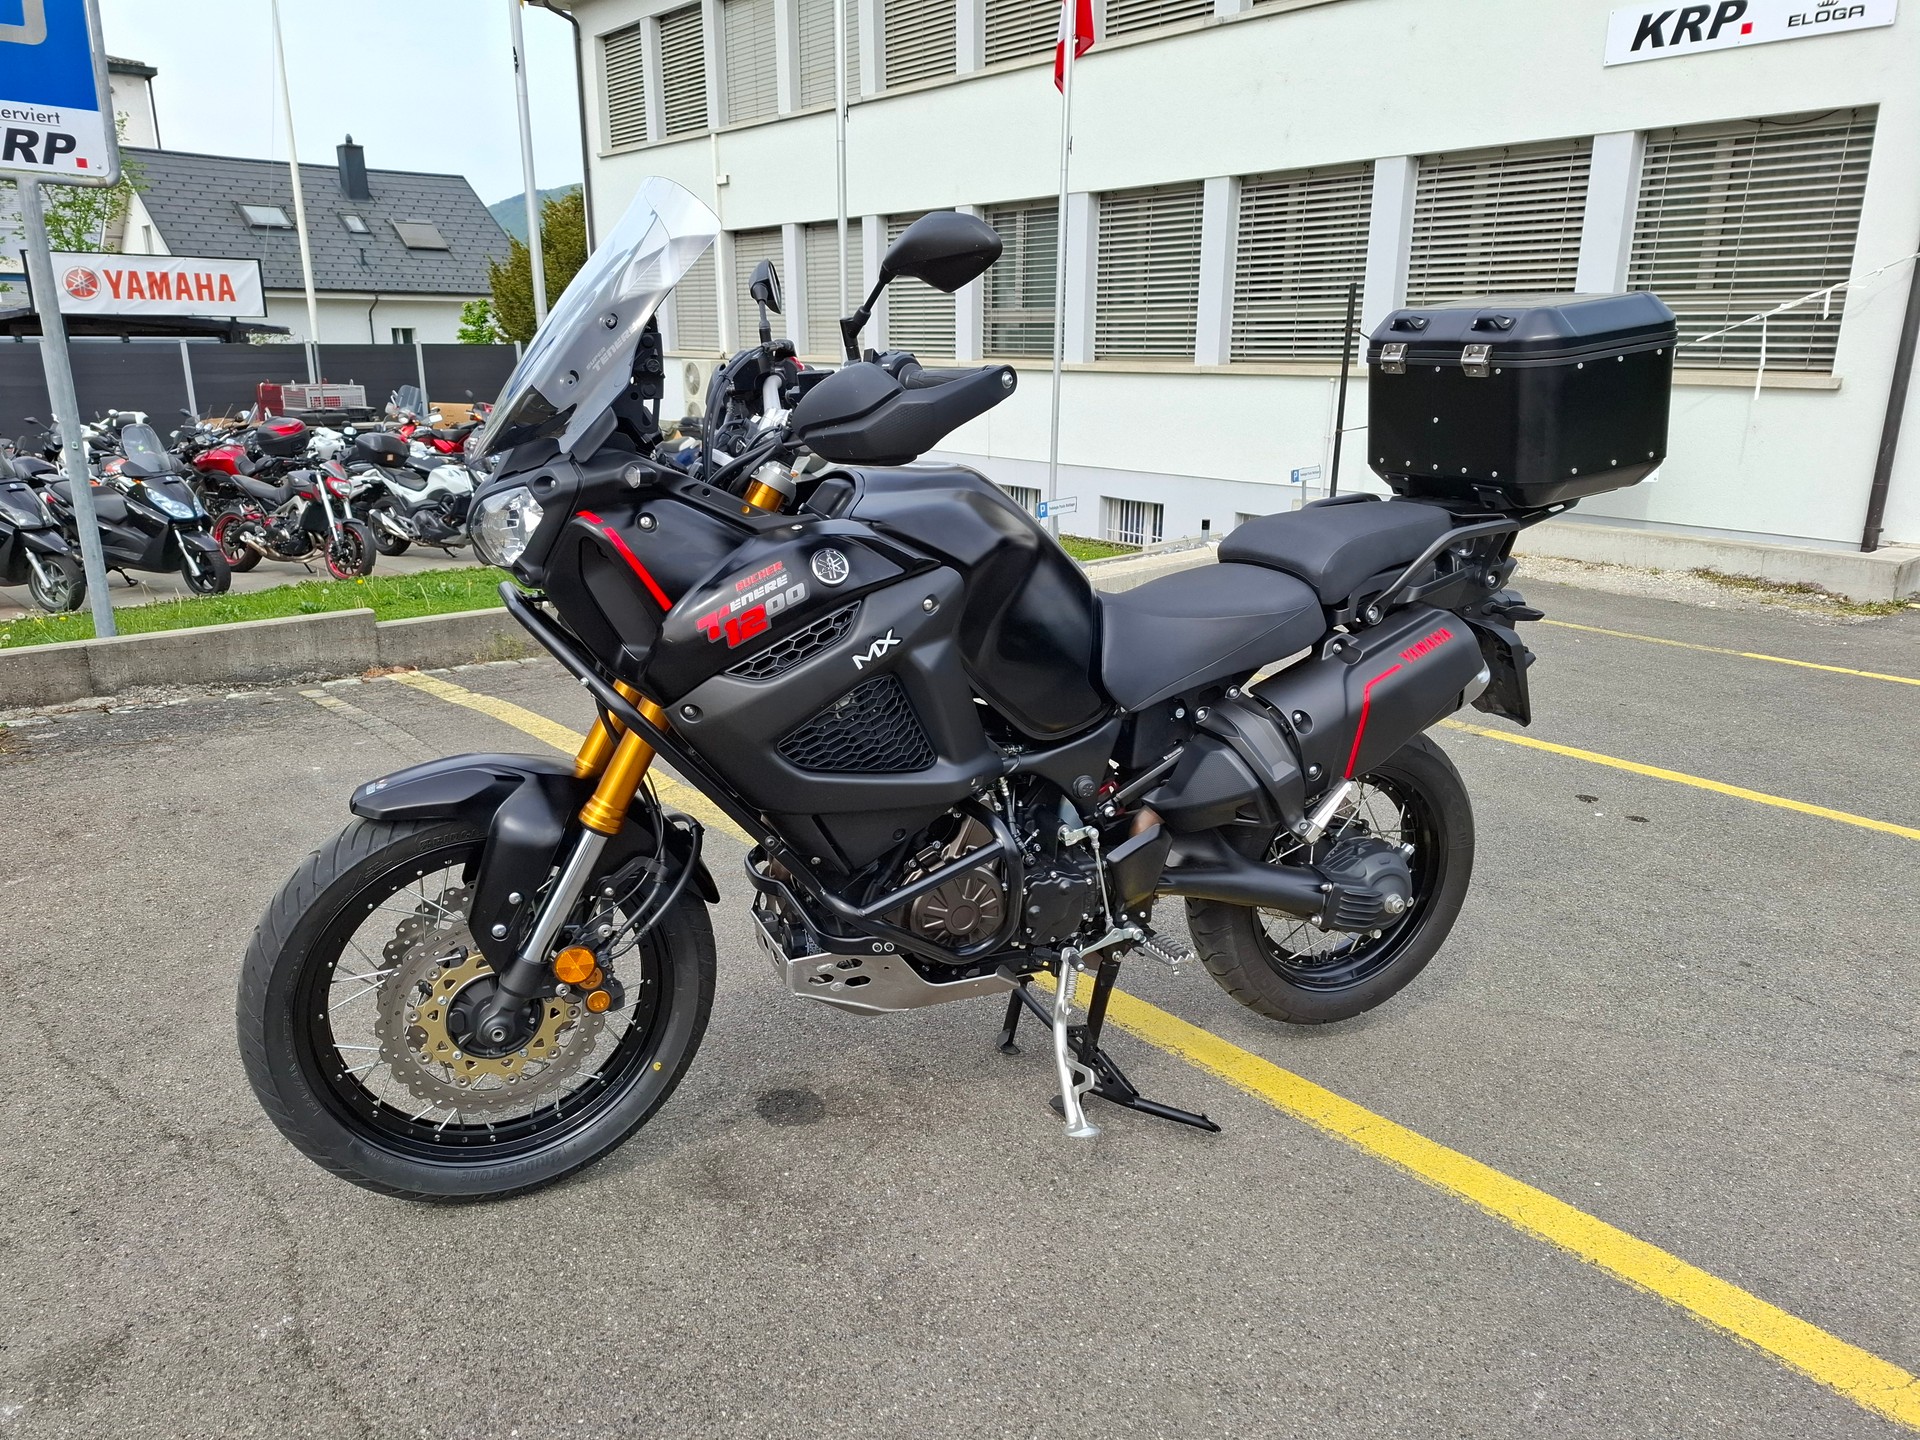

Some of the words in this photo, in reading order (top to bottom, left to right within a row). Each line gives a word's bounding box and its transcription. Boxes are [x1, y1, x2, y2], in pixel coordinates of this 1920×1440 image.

[1788, 5, 1865, 27] ELOGA
[0, 107, 60, 124] erviert
[0, 127, 88, 168] RP.
[103, 269, 236, 302] YAMAHA
[736, 560, 783, 592] BUCHER
[725, 583, 806, 647] 1200
[852, 629, 901, 670] MX
[1399, 627, 1454, 664] YAMAHA
